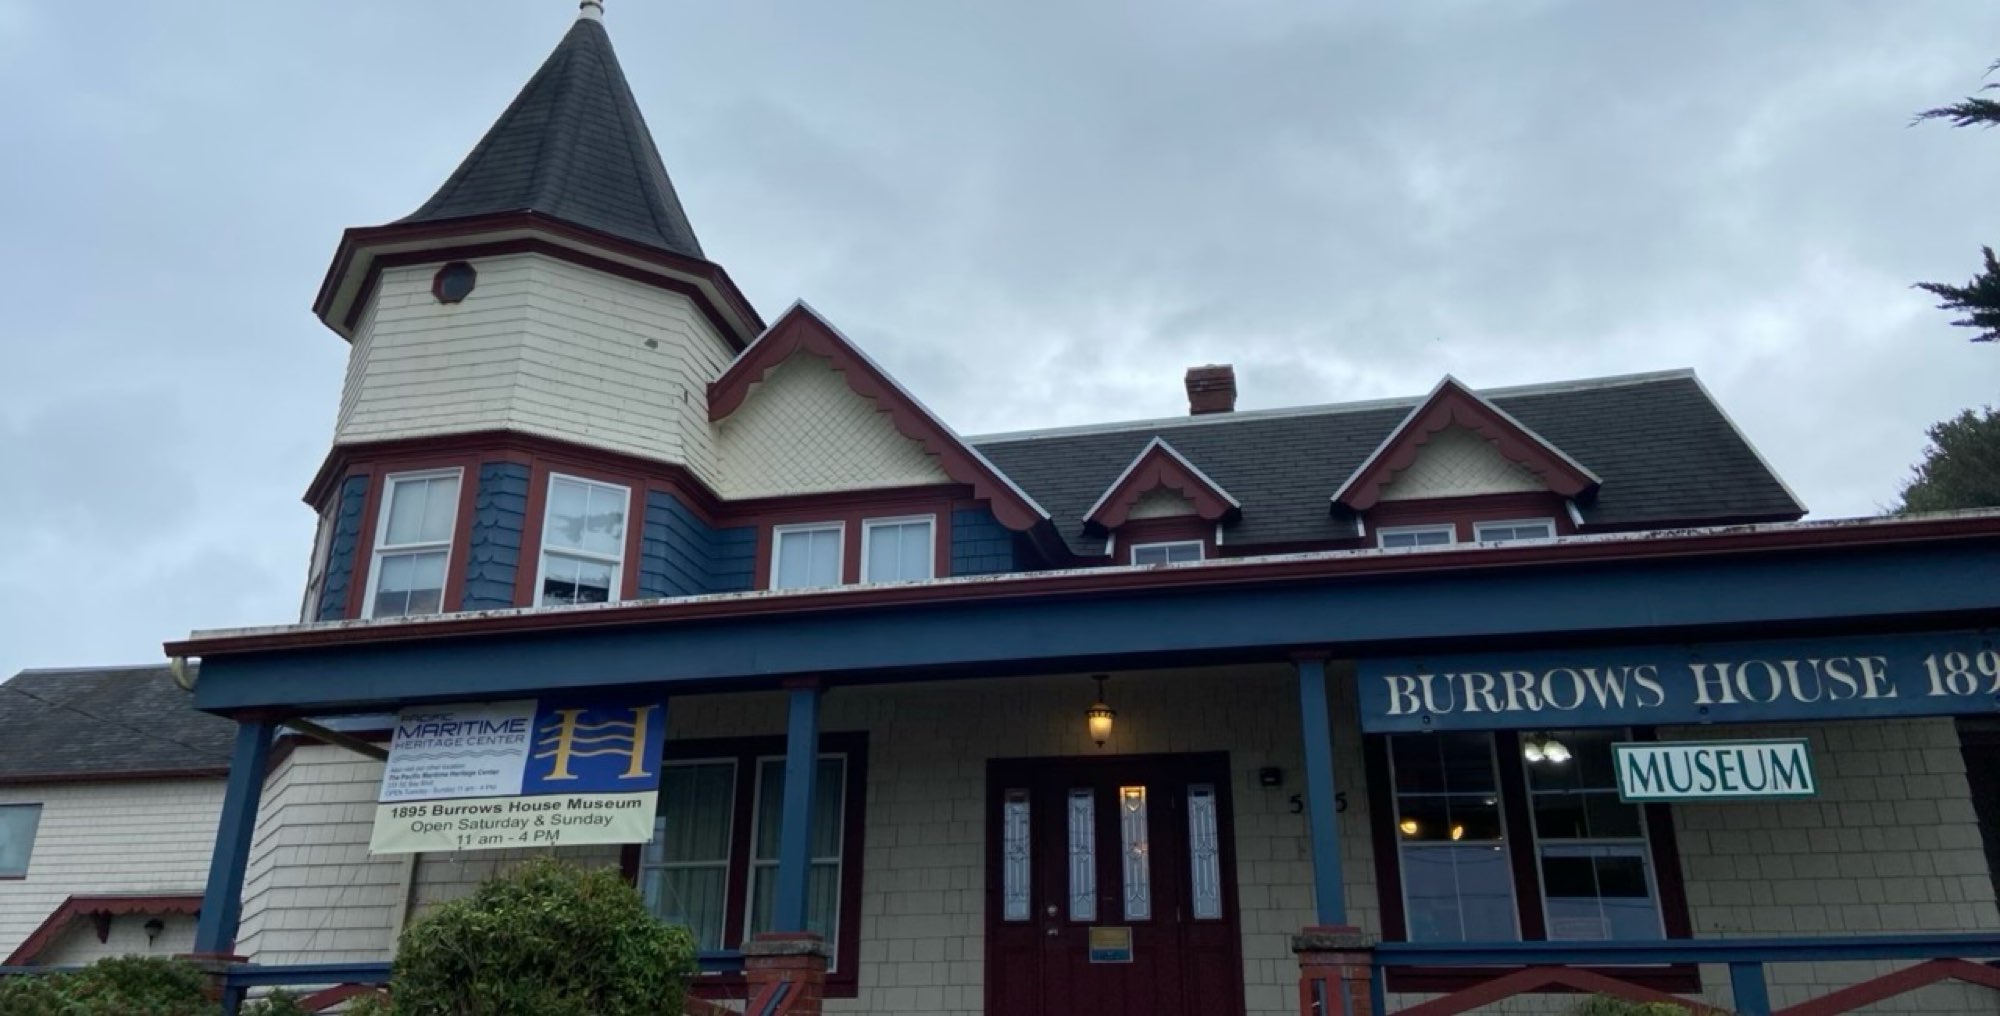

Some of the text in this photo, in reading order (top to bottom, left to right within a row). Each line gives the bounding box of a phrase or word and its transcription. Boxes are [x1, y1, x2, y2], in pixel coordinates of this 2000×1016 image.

[1384, 665, 1665, 715] BURROWS
[1688, 656, 1898, 704] HOUSE
[398, 719, 528, 739] MARITIME
[395, 734, 525, 750] HERITAGE CENTER
[1627, 748, 1809, 793] MUSEUM
[391, 797, 642, 818] 1895 Burrows House Museum
[410, 812, 614, 834] Open Saturday & Sunday
[456, 833, 471, 846] 11
[478, 834, 503, 844] am
[518, 830, 528, 842] 4
[533, 828, 560, 841] PM
